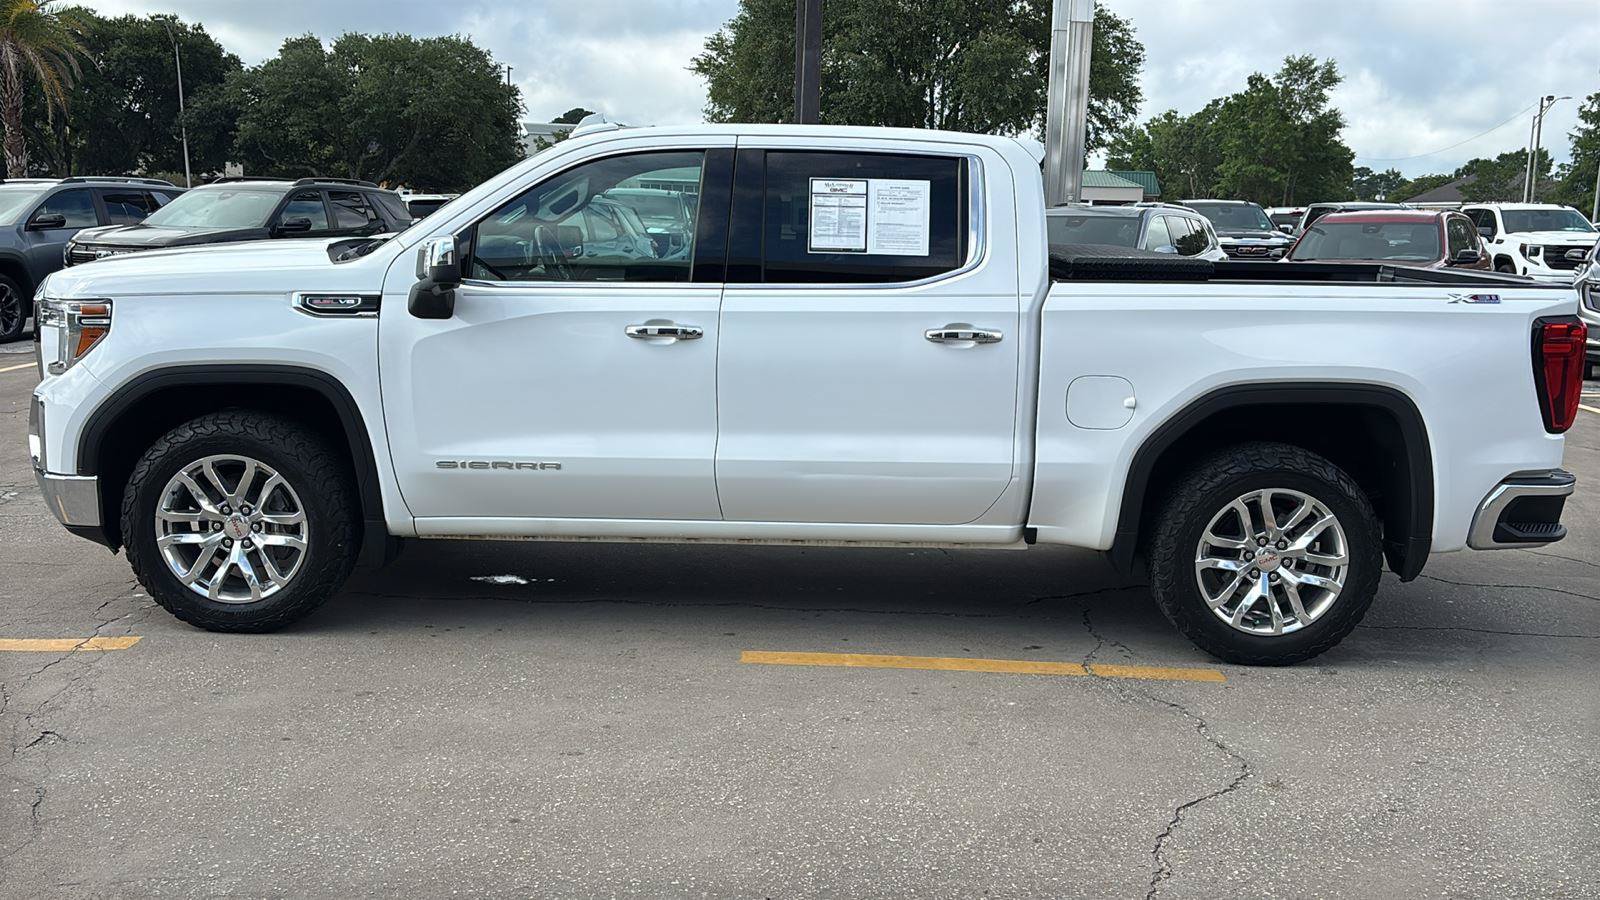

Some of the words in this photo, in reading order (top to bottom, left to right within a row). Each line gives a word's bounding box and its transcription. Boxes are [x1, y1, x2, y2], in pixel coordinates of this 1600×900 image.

[1237, 246, 1268, 254] GMC
[436, 460, 562, 470] SIERRA
[1258, 555, 1278, 565] GMC
